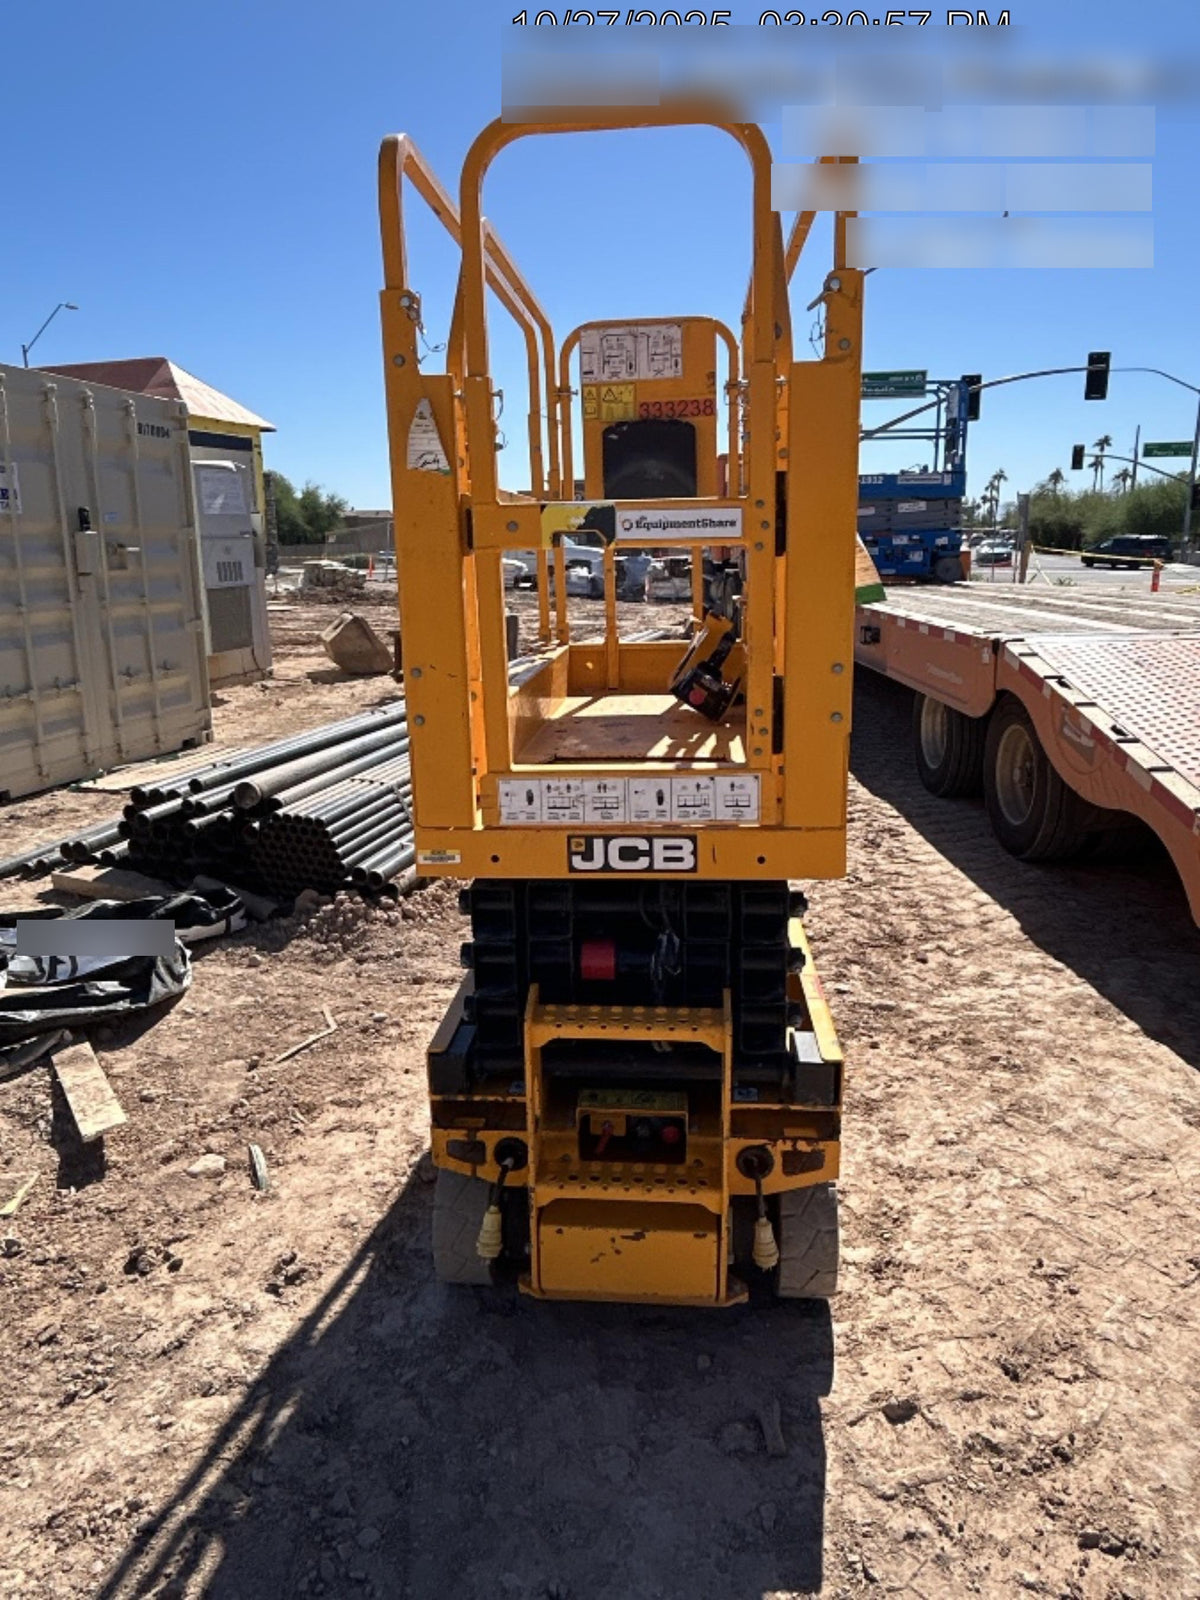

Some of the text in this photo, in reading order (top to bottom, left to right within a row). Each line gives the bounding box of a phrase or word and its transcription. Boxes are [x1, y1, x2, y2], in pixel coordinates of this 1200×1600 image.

[639, 398, 714, 419] 333238
[635, 518, 738, 531] EquipmentShare
[571, 837, 695, 870] JCB
